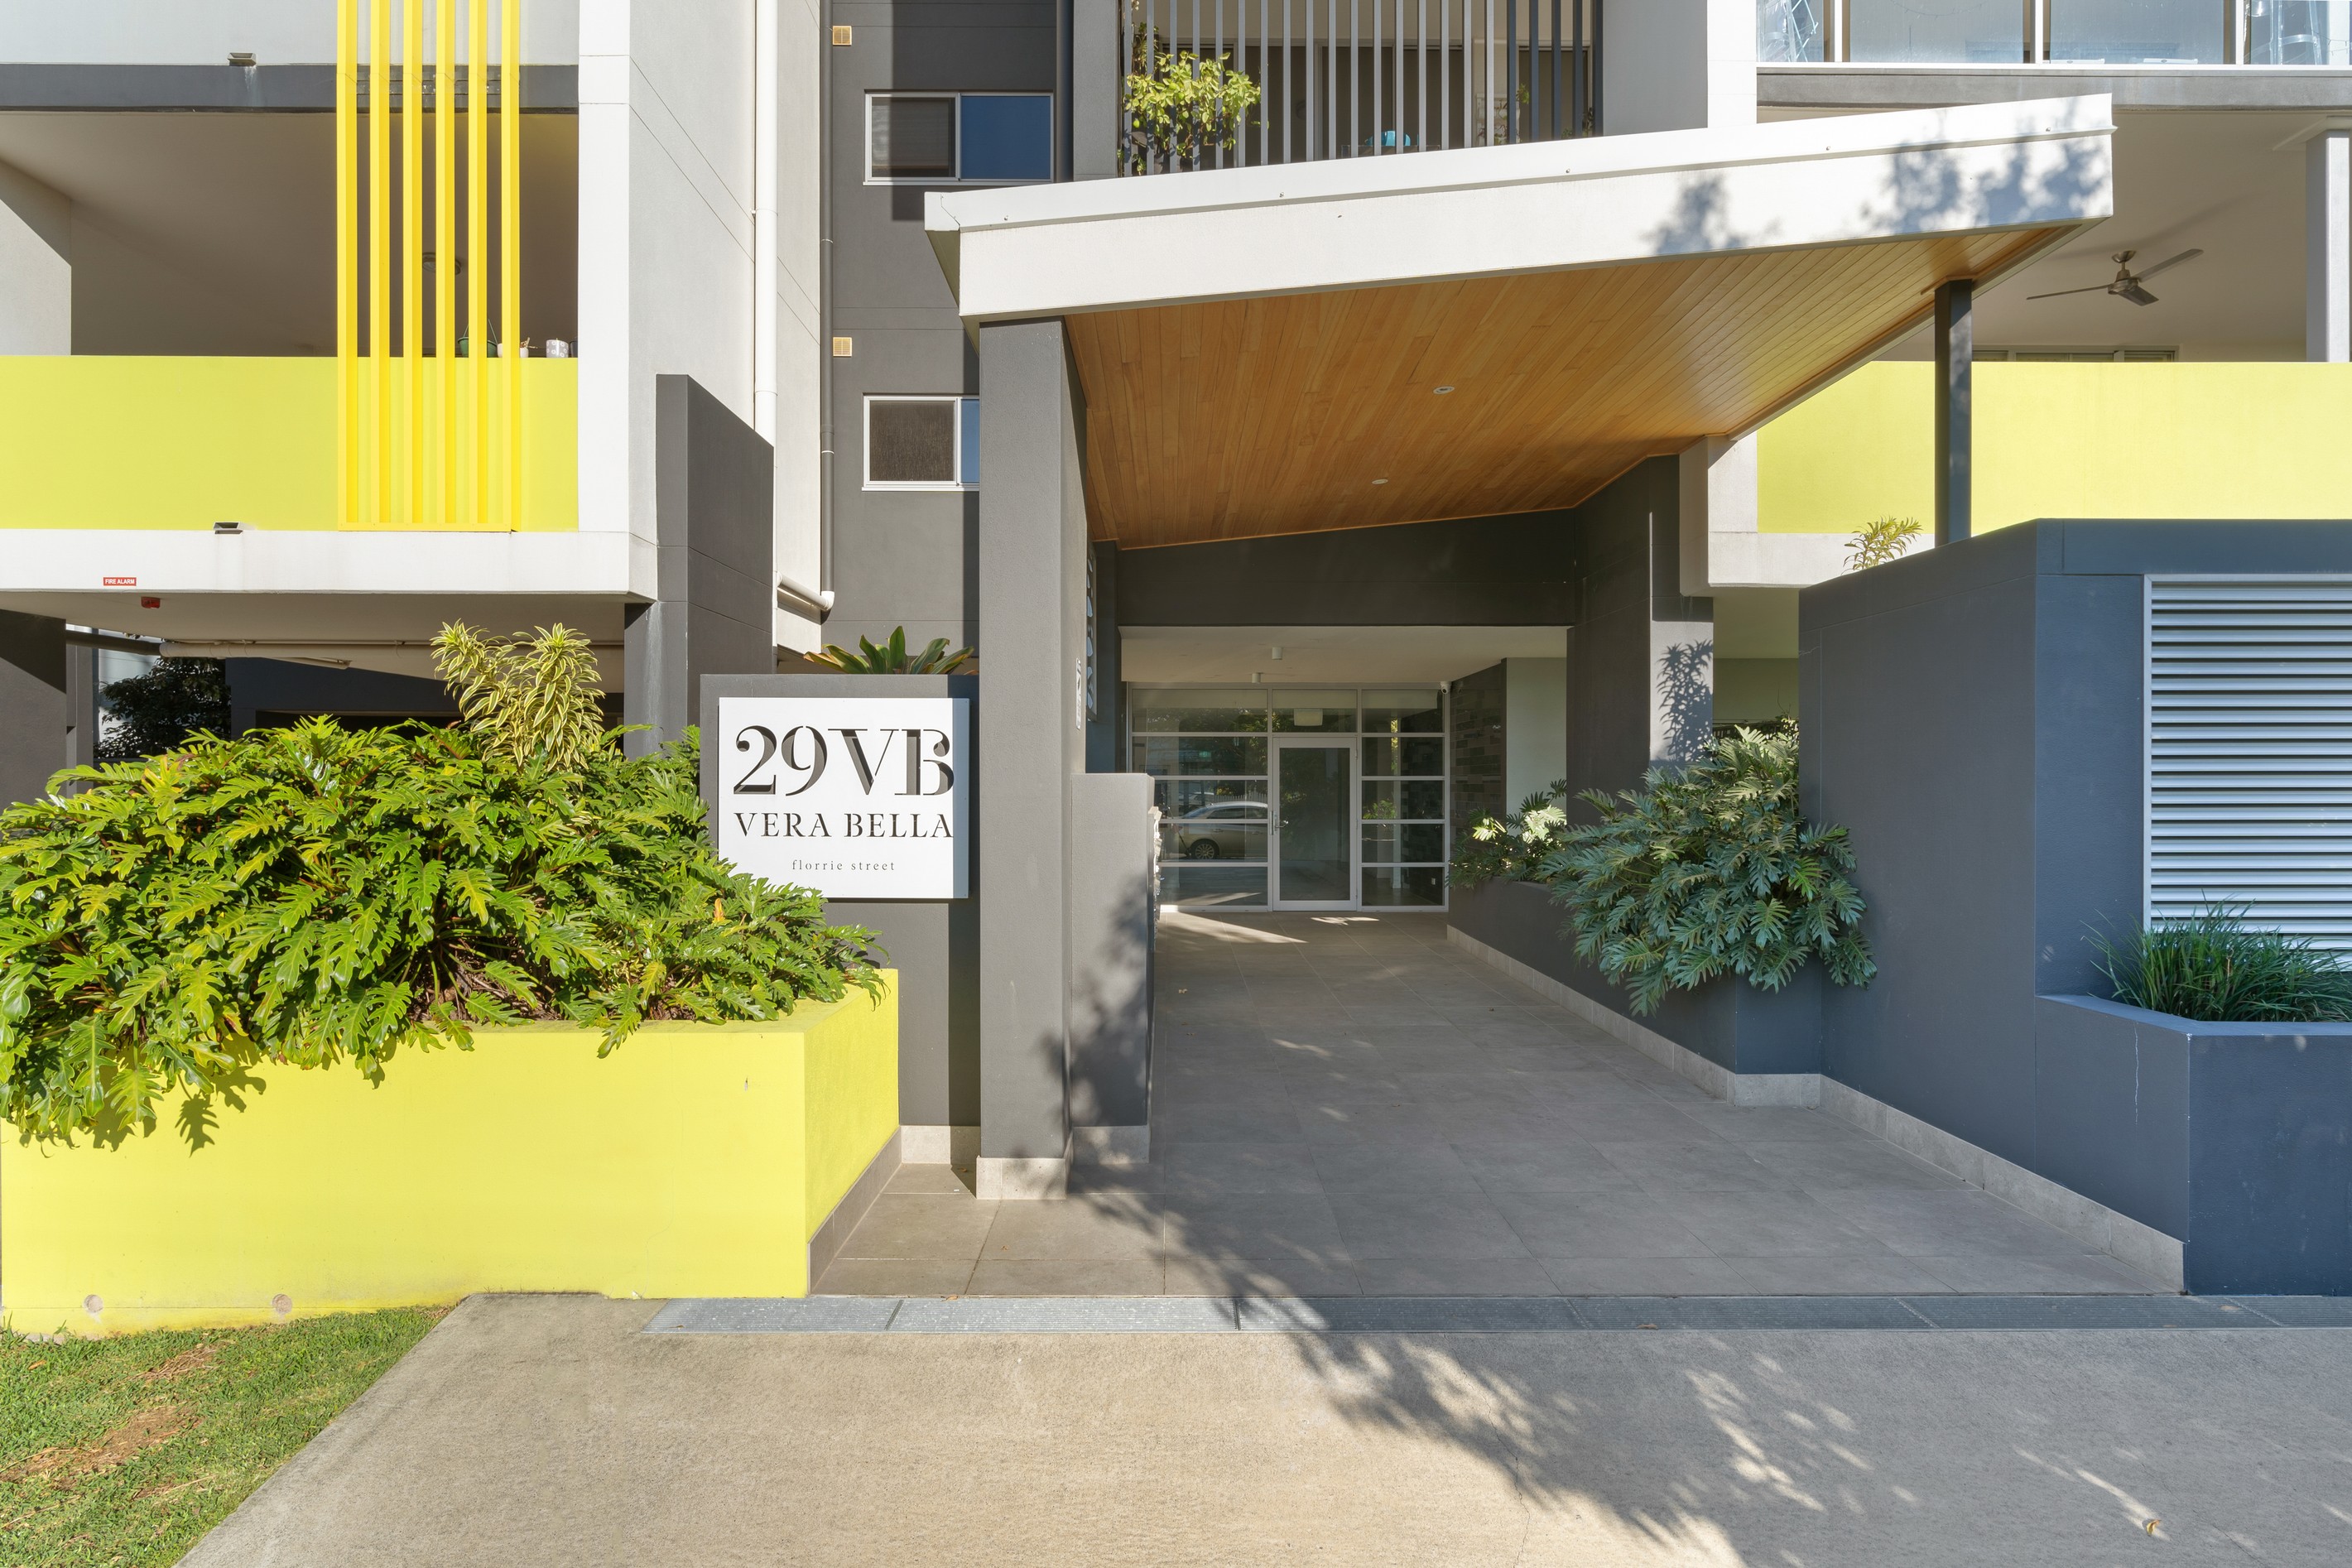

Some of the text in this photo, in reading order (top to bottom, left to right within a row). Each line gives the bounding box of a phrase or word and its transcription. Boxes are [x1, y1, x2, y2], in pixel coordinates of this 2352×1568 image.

[733, 724, 955, 796] 29VB
[733, 812, 954, 838] VERA BELLA
[791, 859, 895, 871] florrie street
